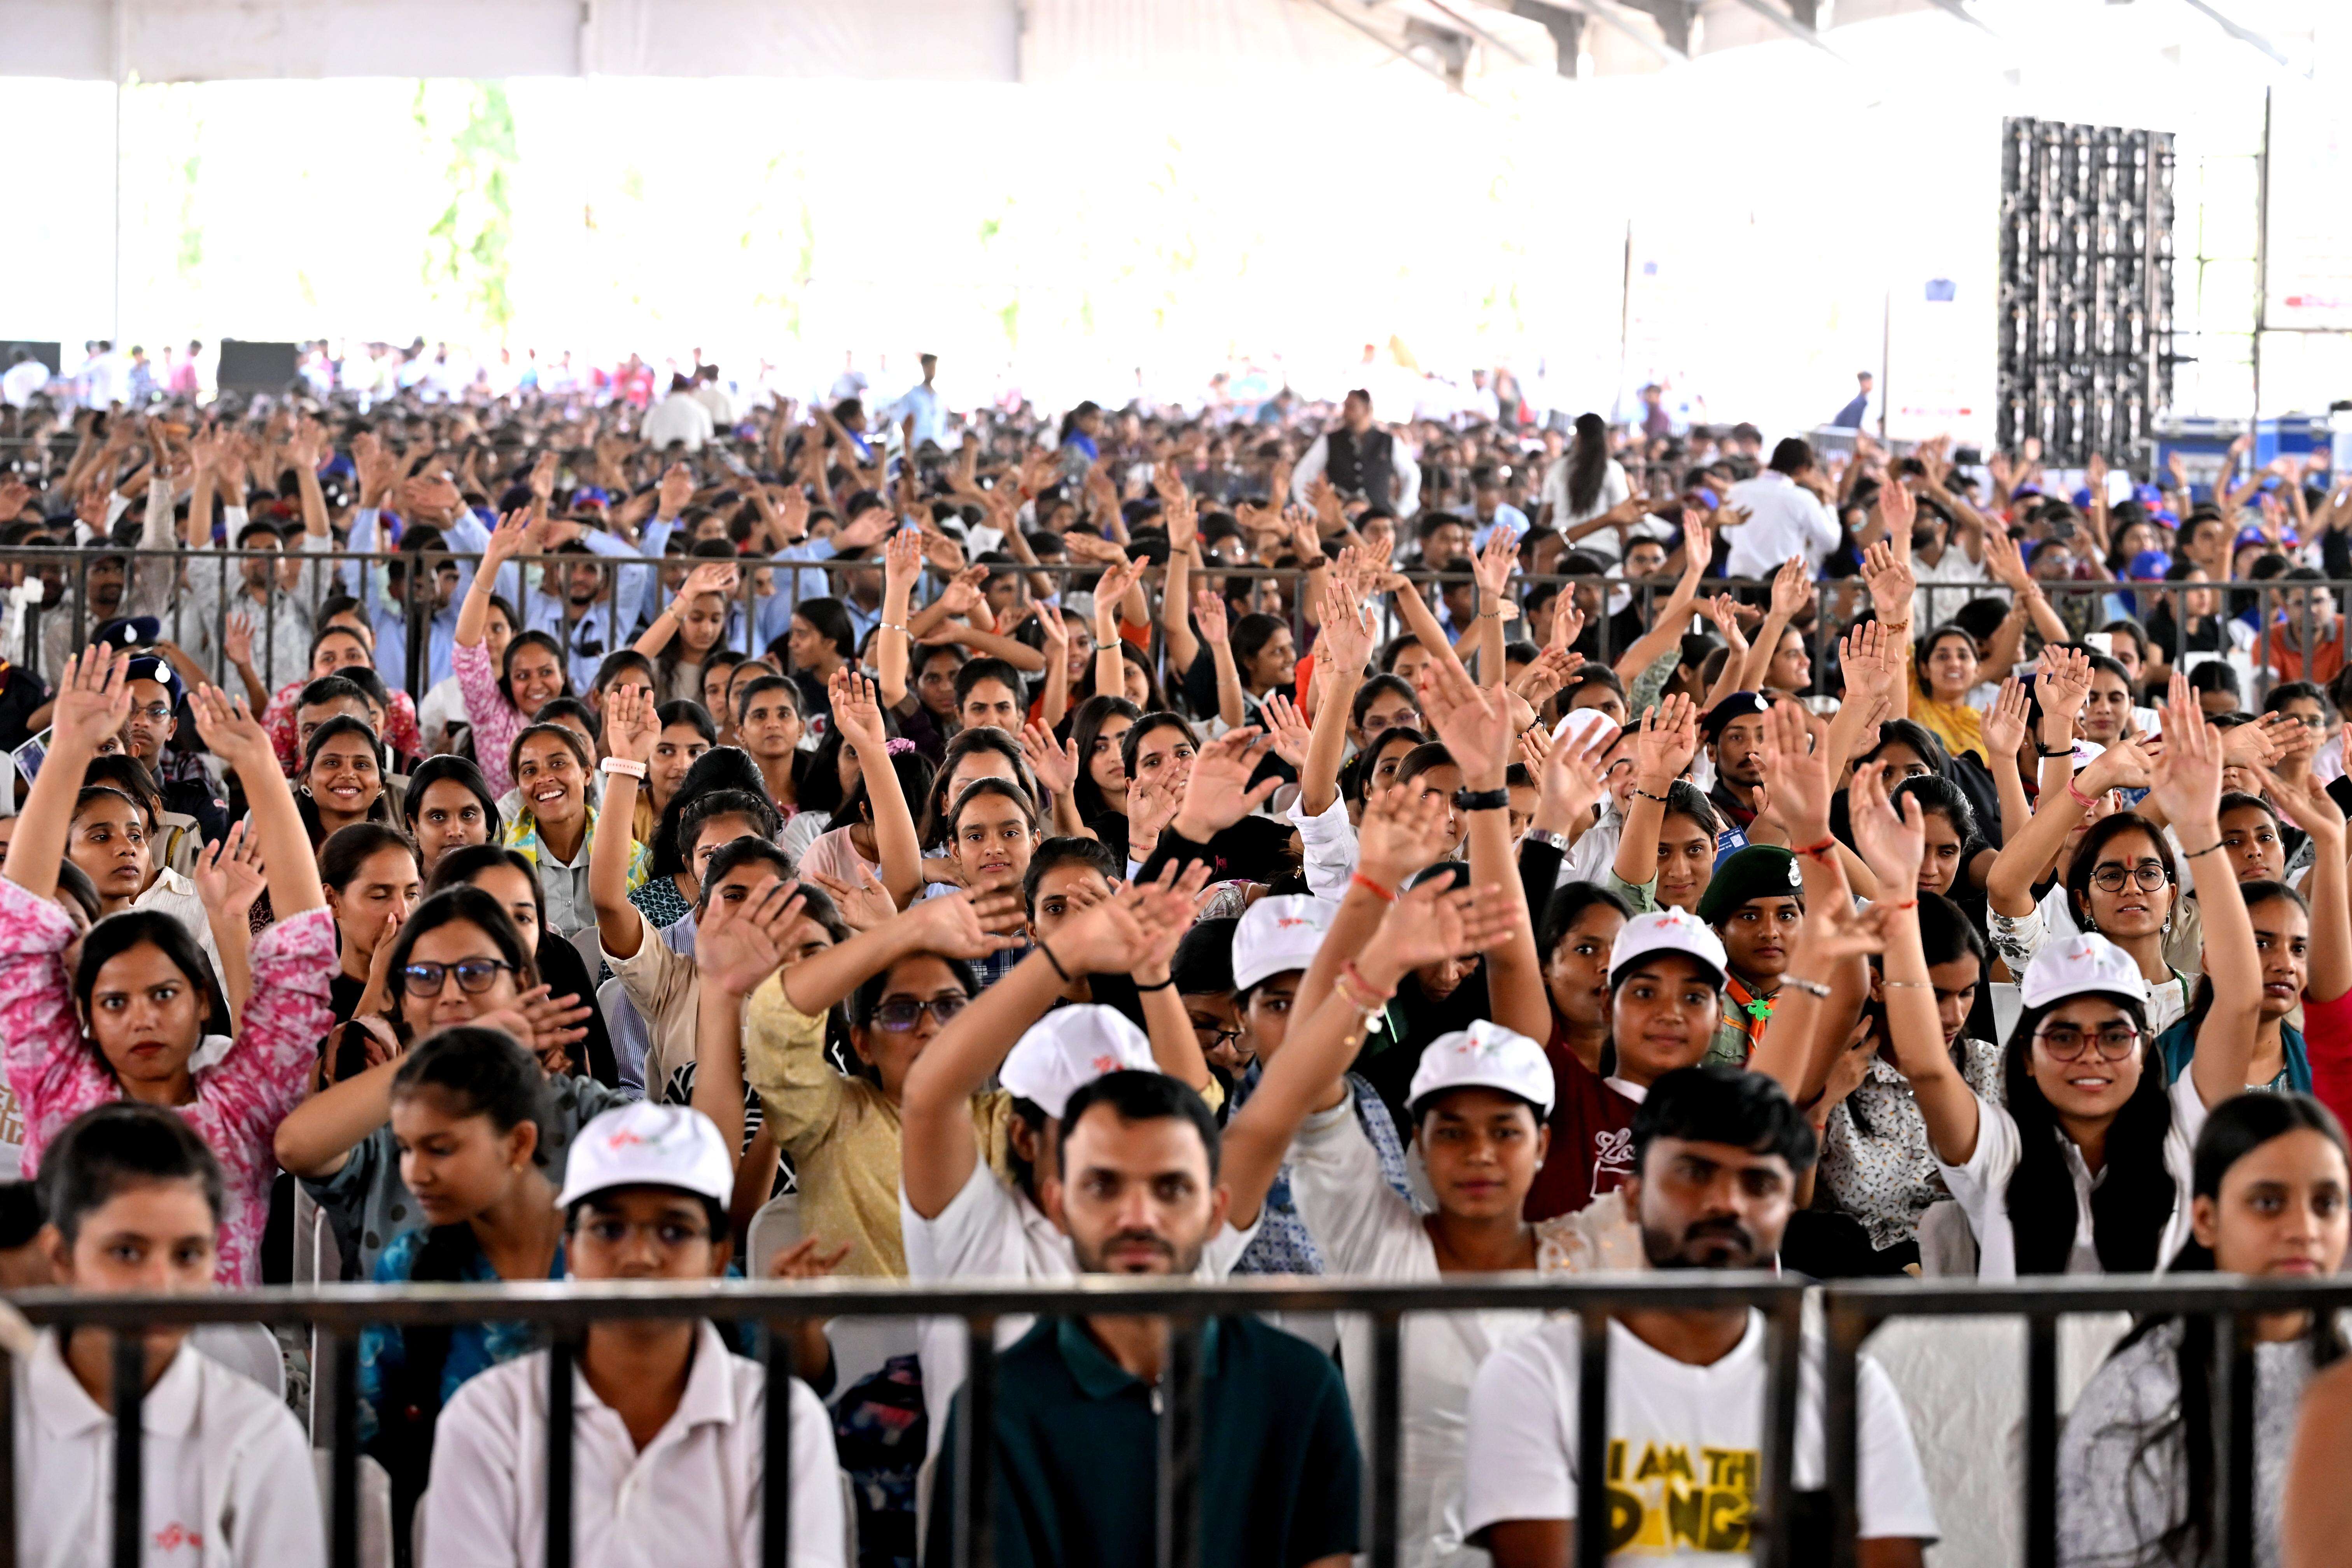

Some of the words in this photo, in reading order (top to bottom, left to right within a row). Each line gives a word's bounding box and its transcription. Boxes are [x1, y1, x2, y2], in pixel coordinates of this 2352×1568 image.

[1609, 1439, 1626, 1482] I
[1634, 1440, 1695, 1482] AM
[1701, 1449, 1761, 1489] TH
